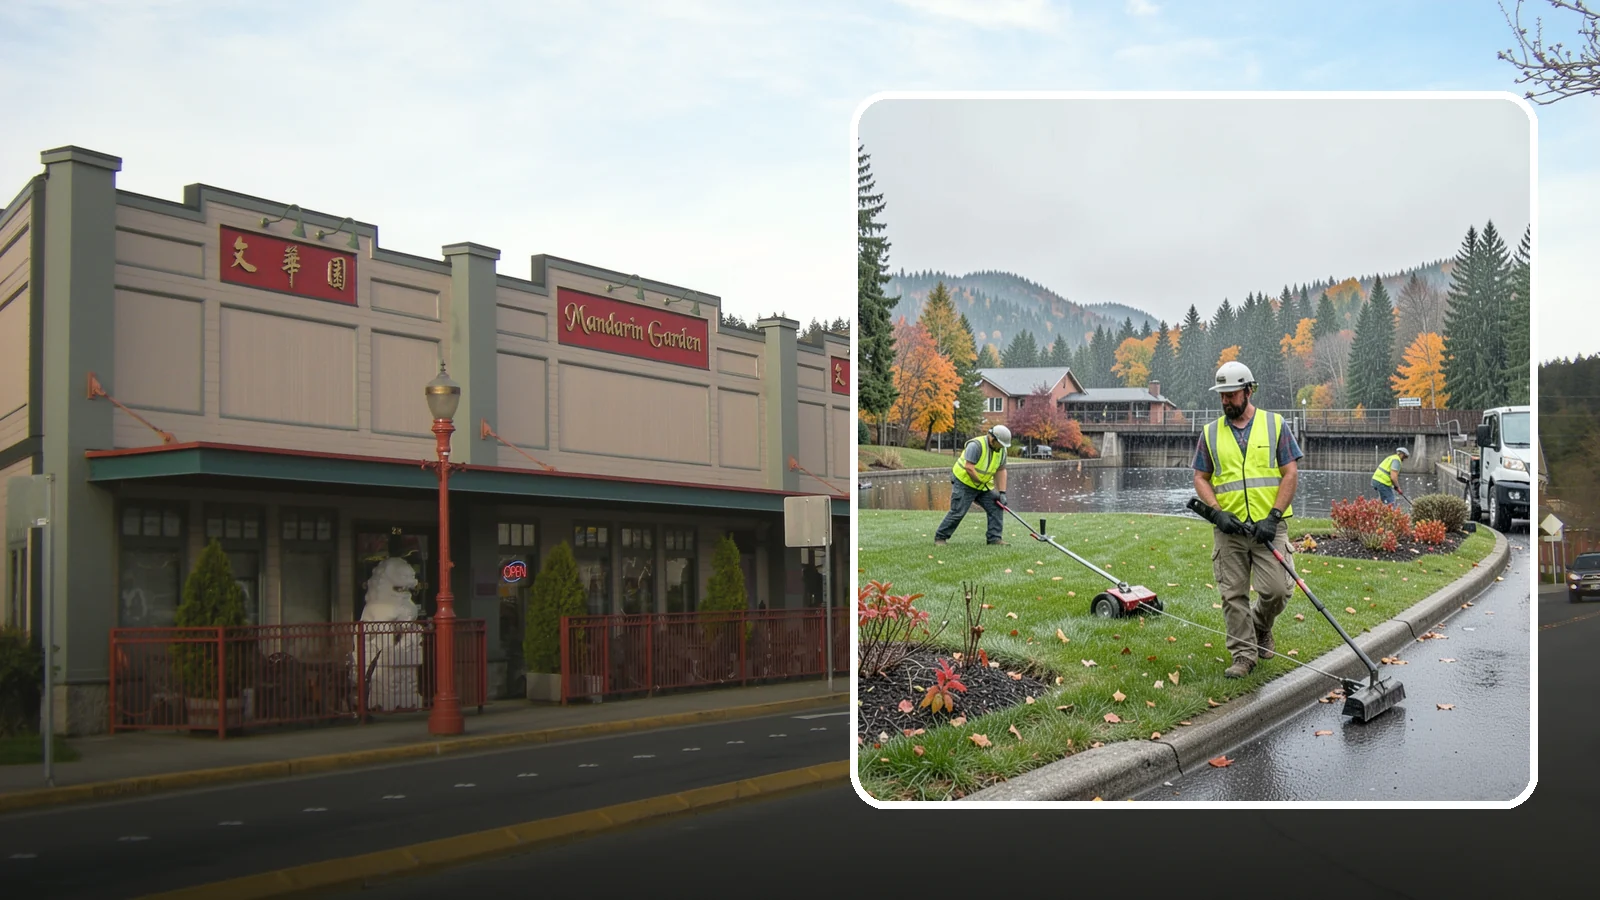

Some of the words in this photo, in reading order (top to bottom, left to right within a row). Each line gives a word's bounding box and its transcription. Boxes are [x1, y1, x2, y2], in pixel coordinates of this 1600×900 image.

[231, 235, 346, 291] 文華園
[564, 302, 644, 341] Mandarin
[647, 320, 701, 352] Garden
[503, 565, 527, 578] OPEN
